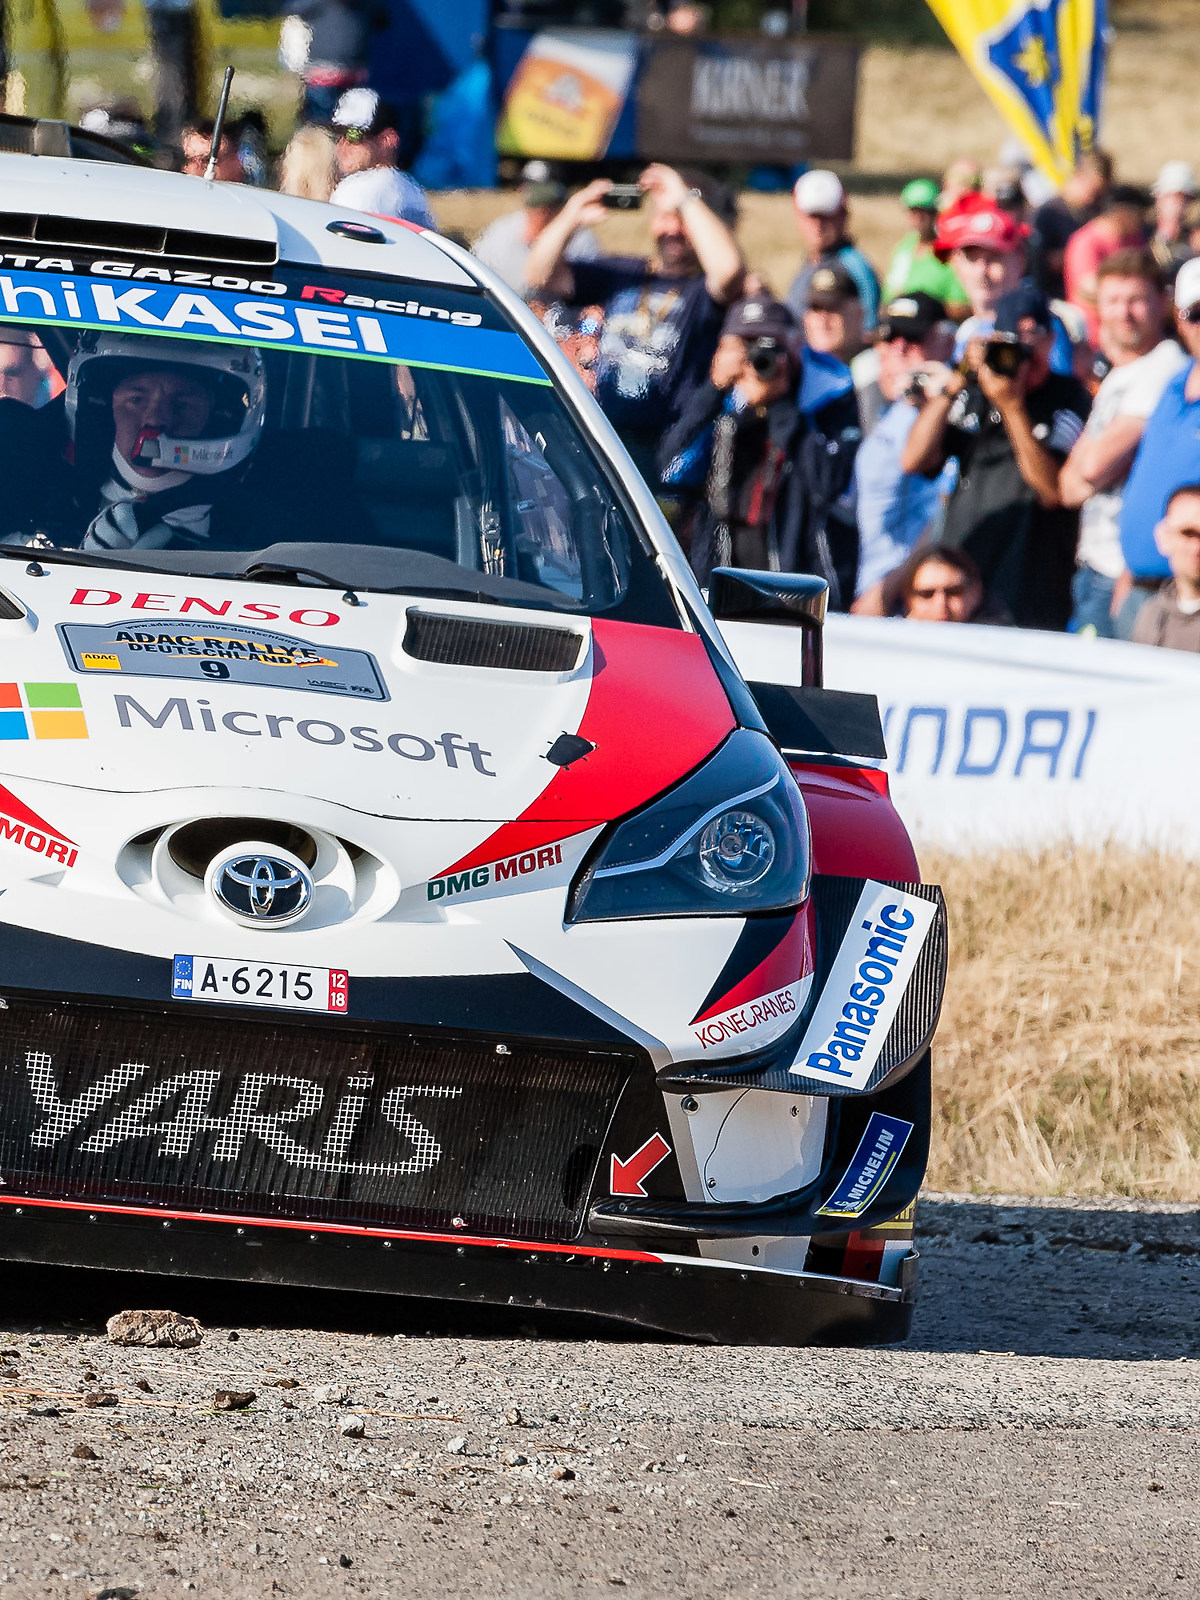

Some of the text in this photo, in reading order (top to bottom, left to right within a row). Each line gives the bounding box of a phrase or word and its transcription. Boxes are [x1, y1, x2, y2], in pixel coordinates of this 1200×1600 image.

[90, 261, 287, 295] GAZOO
[301, 285, 482, 327] Racing
[69, 588, 340, 626] DENSO
[84, 653, 117, 661] ADAC
[115, 631, 317, 658] ADAC RALLYE
[128, 643, 293, 665] DEUTSCHLAND
[200, 660, 231, 680] 9
[114, 694, 497, 777] Microsoft
[885, 706, 1097, 780] NDAI
[427, 844, 563, 901] DMG MORI
[174, 978, 193, 991] FIN
[200, 962, 313, 1001] A-6215
[330, 992, 346, 1008] 18
[331, 973, 346, 989] 12
[806, 903, 916, 1078] Panasonic
[694, 990, 797, 1050] KONECRANES
[848, 1128, 895, 1200] MICHELIN
